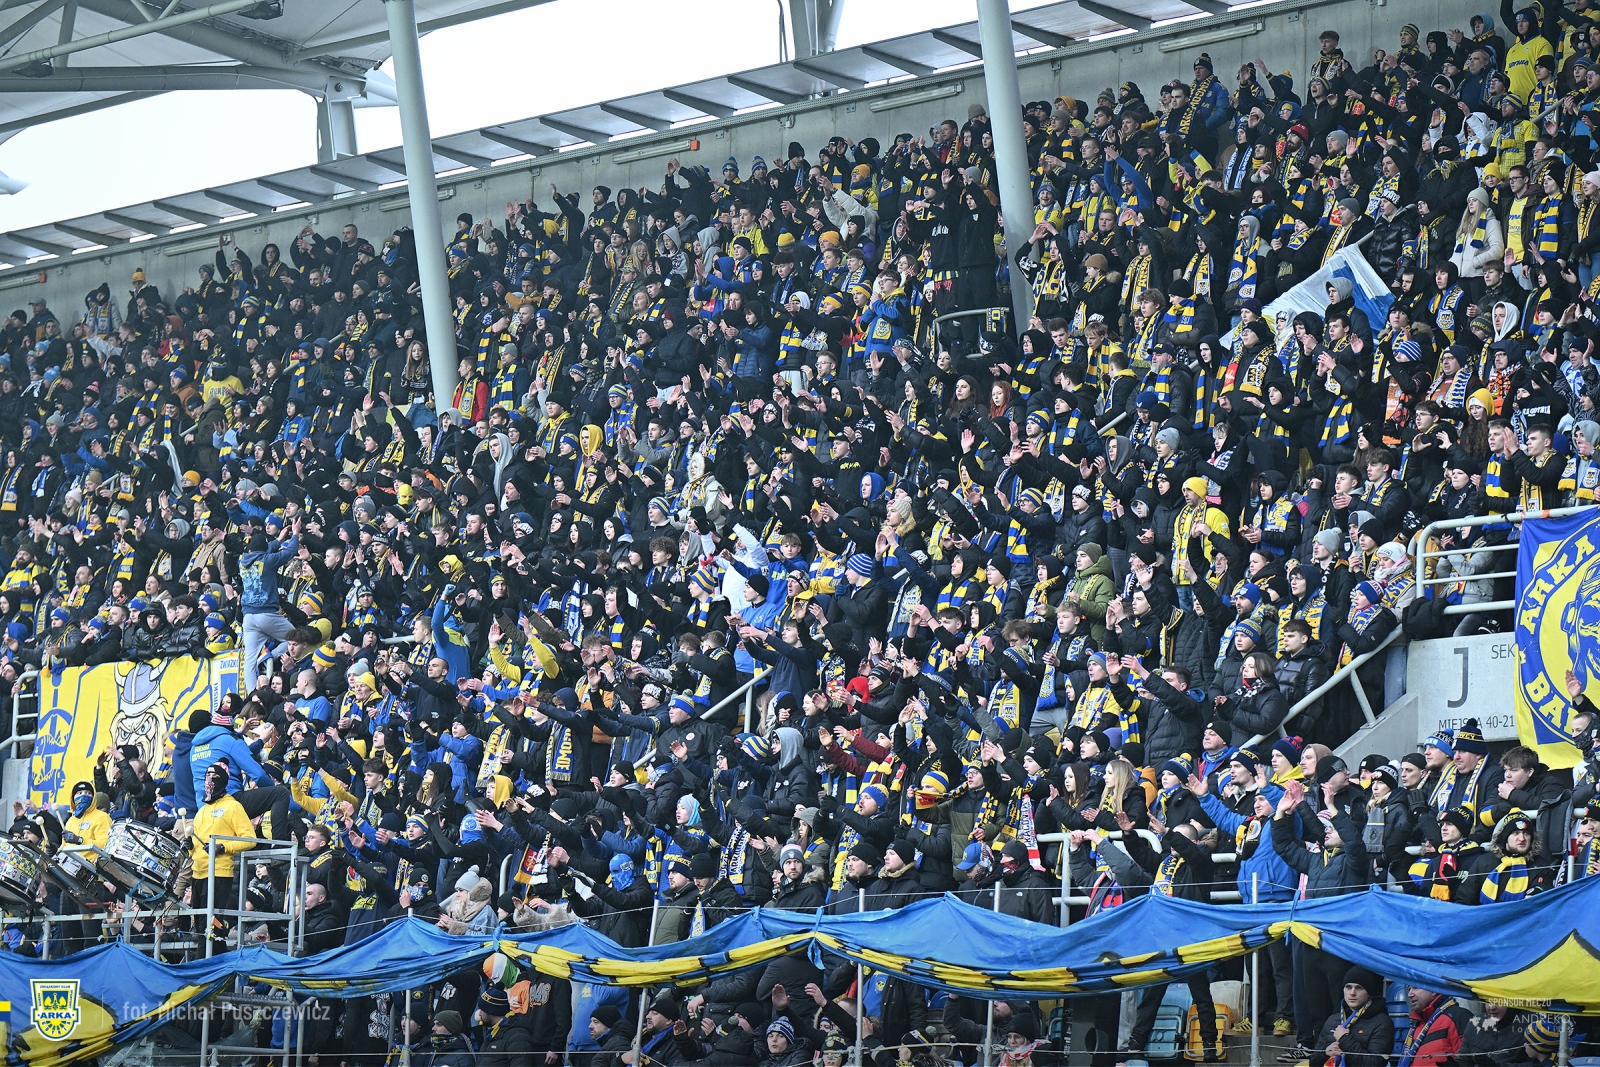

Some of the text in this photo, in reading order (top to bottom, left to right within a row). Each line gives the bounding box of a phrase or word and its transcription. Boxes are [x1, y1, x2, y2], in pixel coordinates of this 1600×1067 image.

[1520, 534, 1595, 635] ARKA
[1446, 647, 1469, 708] J
[1486, 714, 1515, 728] 40-21
